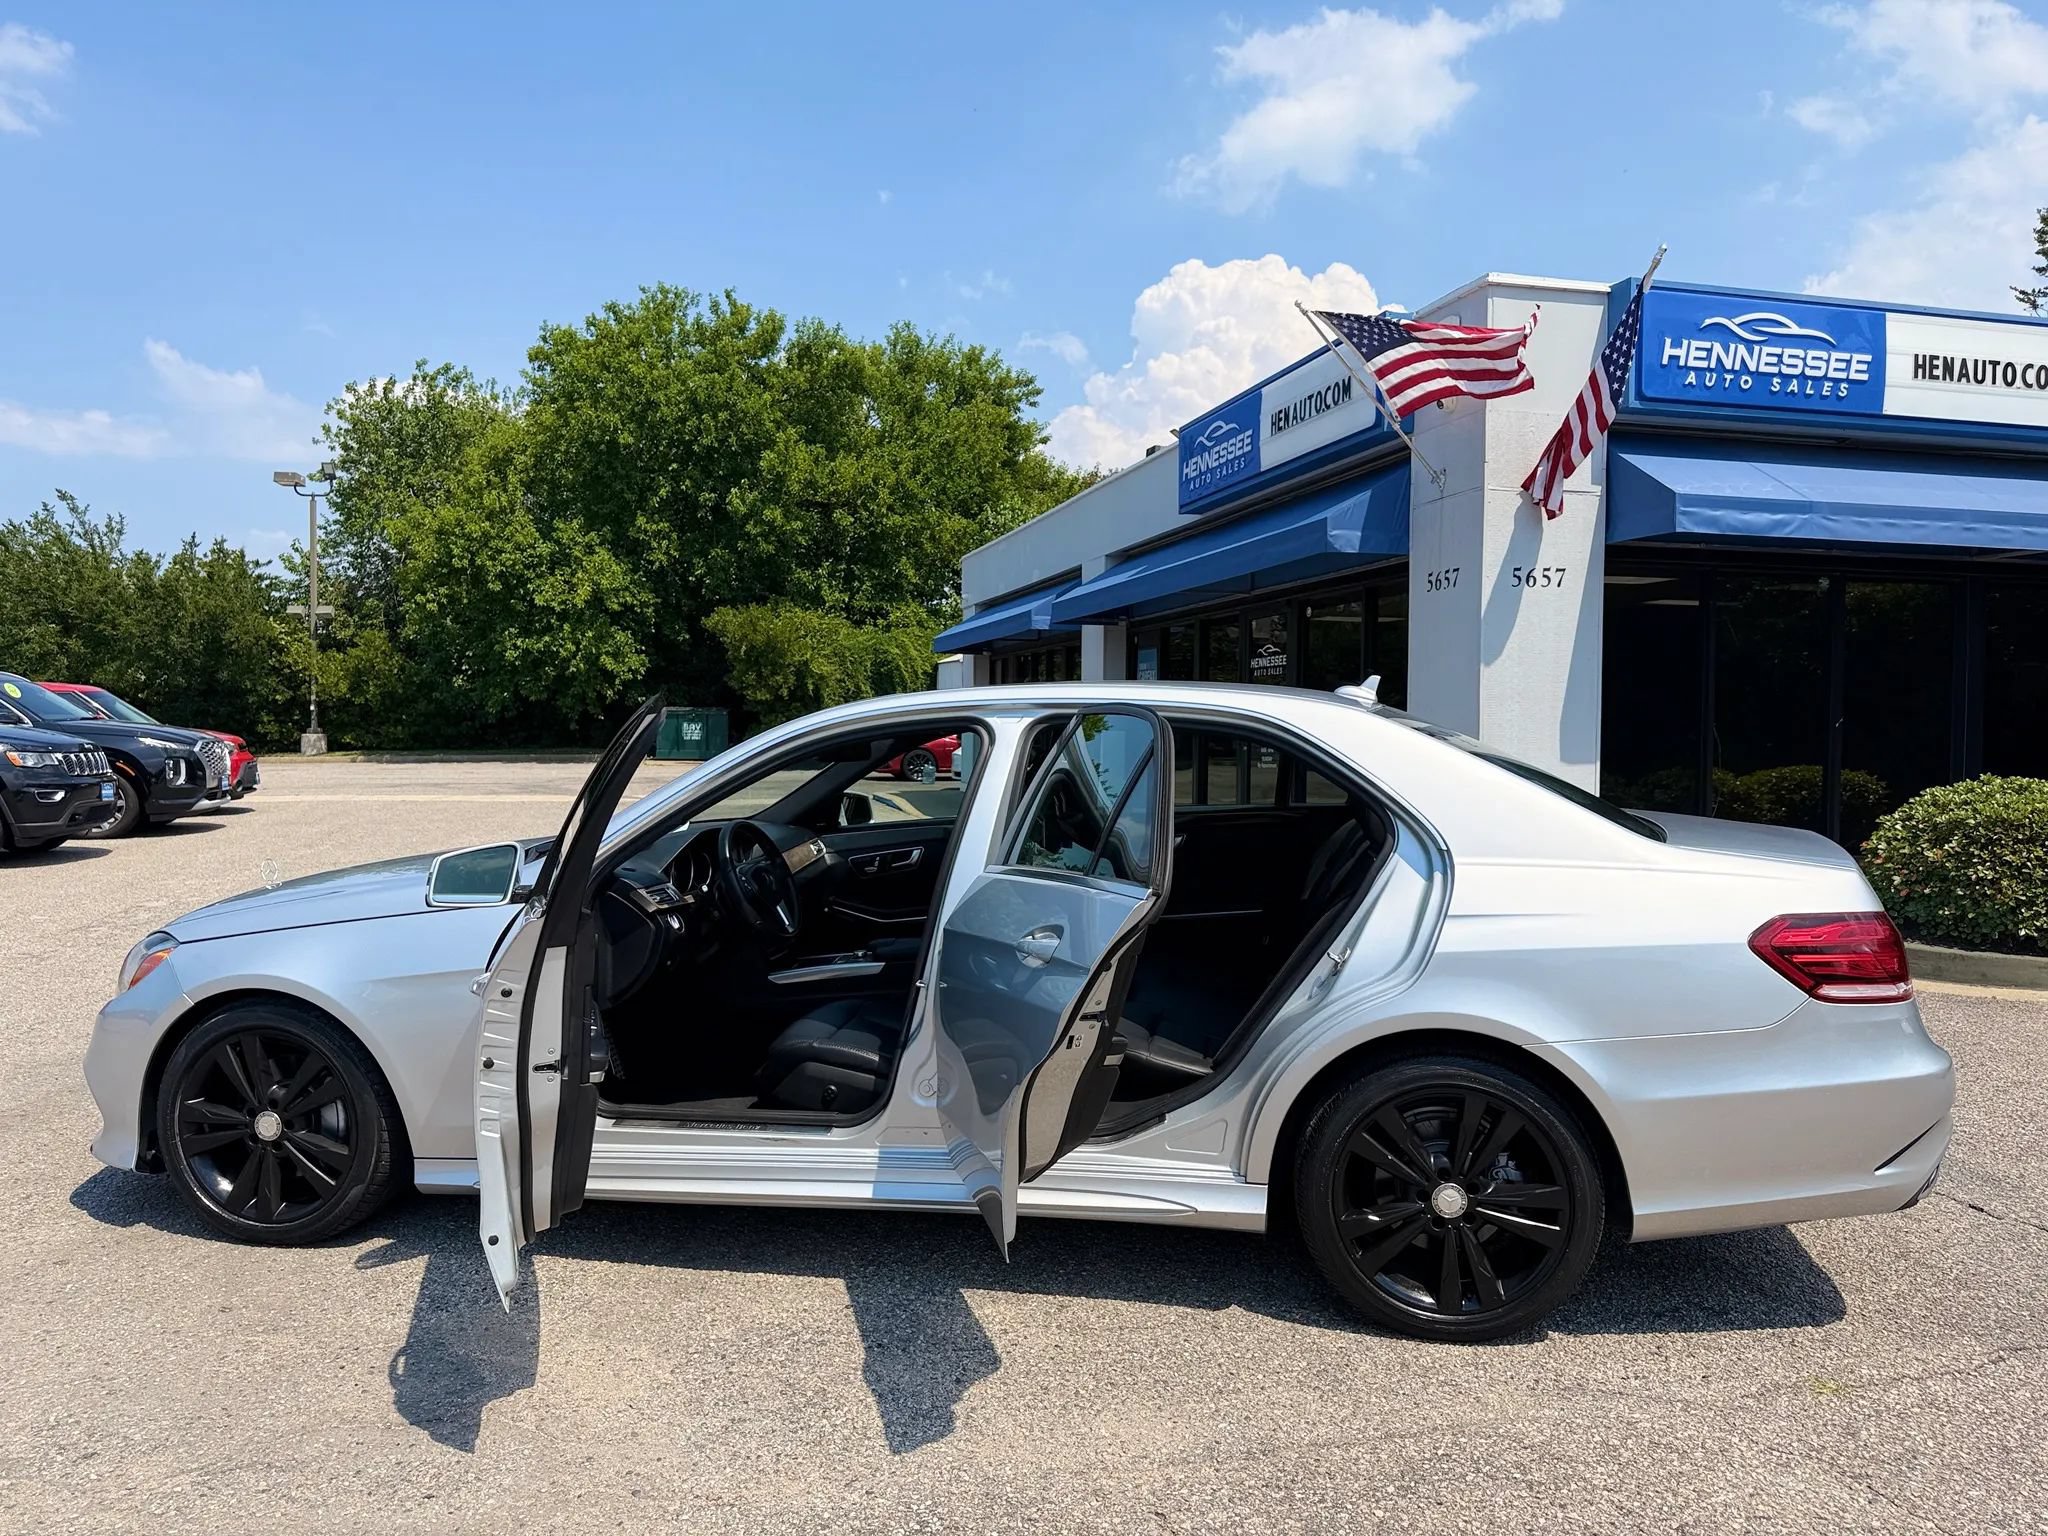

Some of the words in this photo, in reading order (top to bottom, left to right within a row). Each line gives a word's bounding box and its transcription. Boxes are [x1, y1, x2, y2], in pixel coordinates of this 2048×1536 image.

[1661, 337, 1873, 381] HENNESSEE
[1684, 370, 1753, 390] AUTO
[1770, 376, 1849, 398] SALES
[1270, 375, 1352, 437] HENAUTO.COM
[1182, 429, 1254, 482] HENNESSEE
[1189, 474, 1211, 491] AUTO
[1216, 457, 1245, 479] SALES
[1426, 567, 1460, 593] 5657
[1511, 566, 1566, 588] 5657
[1250, 655, 1287, 668] HENNESSEE
[1267, 667, 1282, 676] SALES
